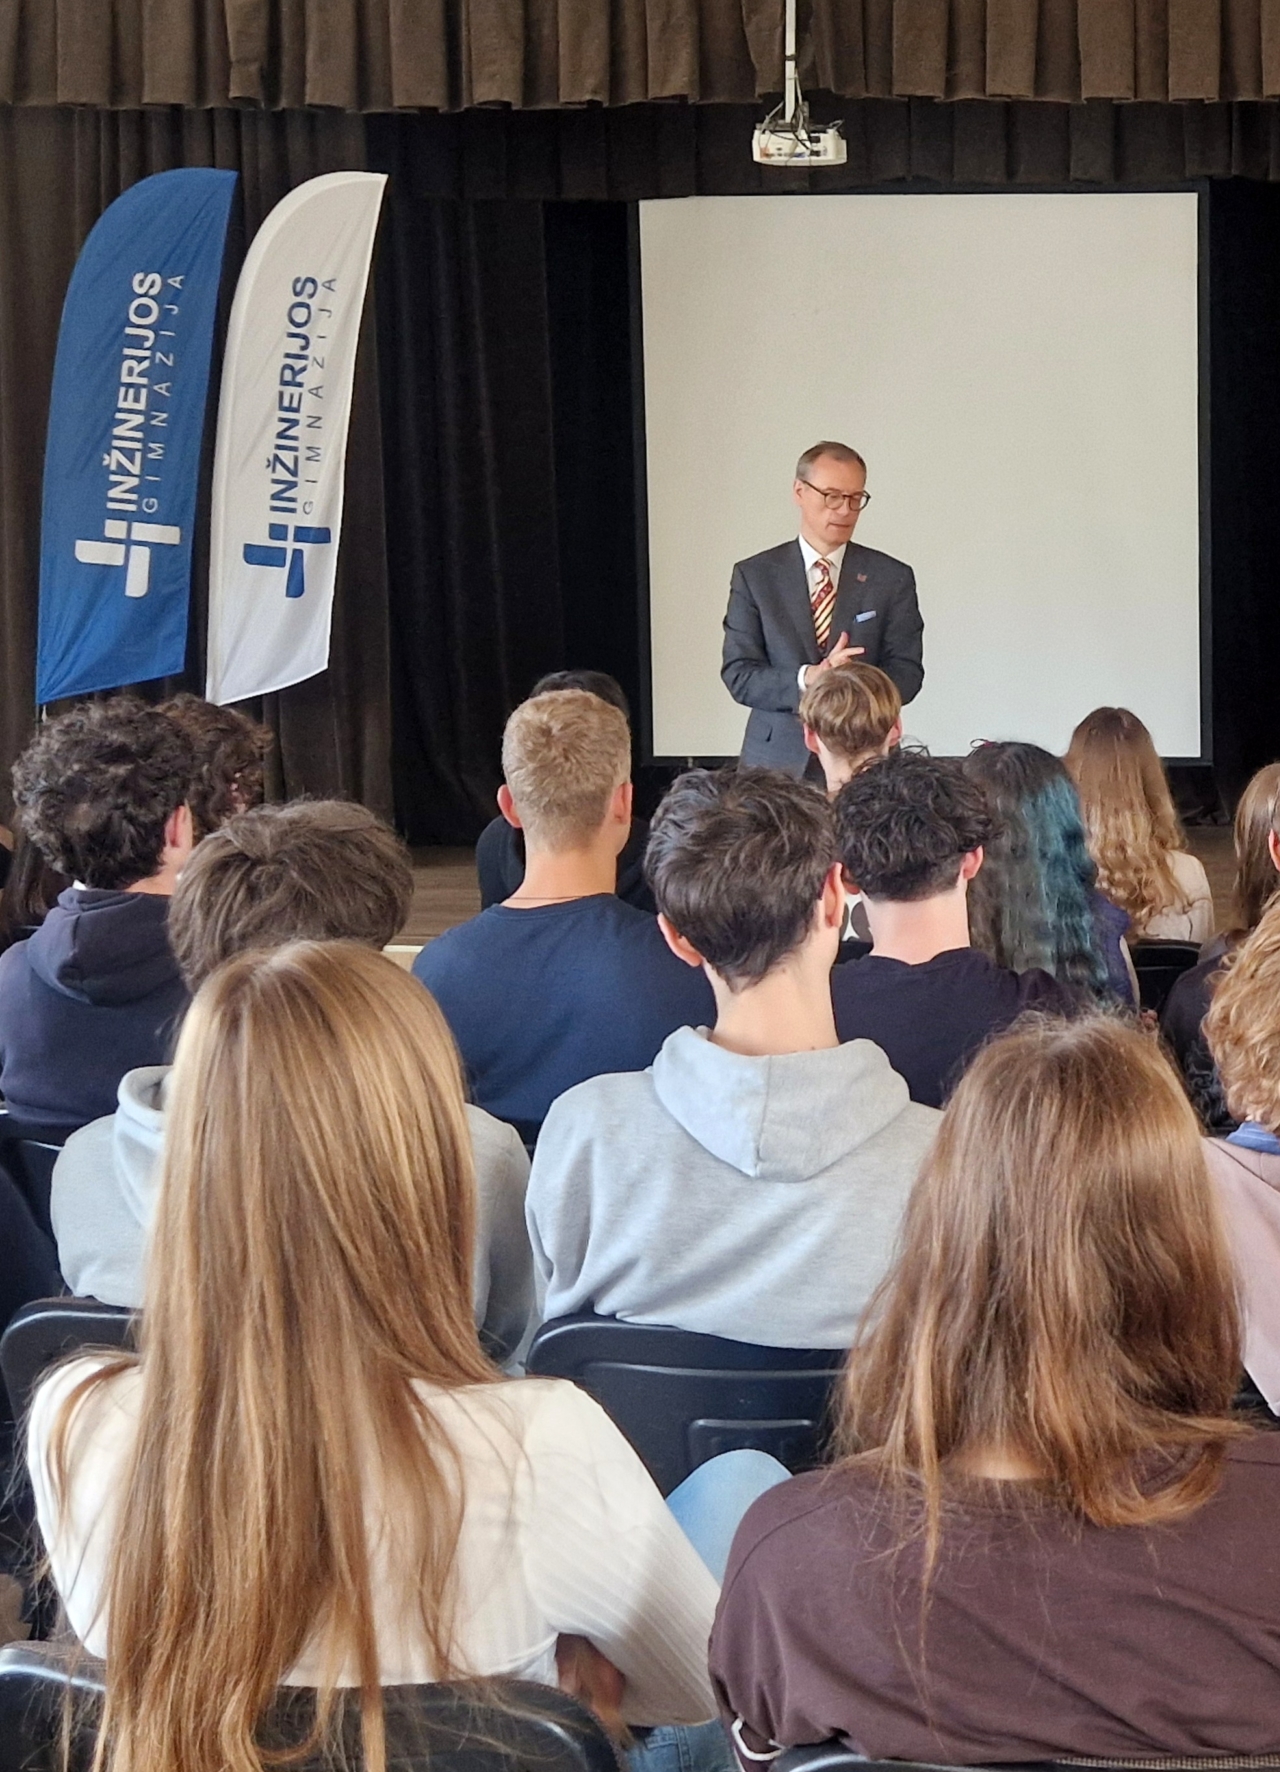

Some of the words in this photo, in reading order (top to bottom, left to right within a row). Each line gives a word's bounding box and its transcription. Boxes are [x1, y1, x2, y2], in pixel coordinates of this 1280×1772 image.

[102, 271, 162, 513] INŽINERIJOS
[142, 274, 185, 514] GIMNAZIJA
[266, 276, 318, 513] INŽINERIJOS
[302, 277, 337, 515] GIMNAZIJA
